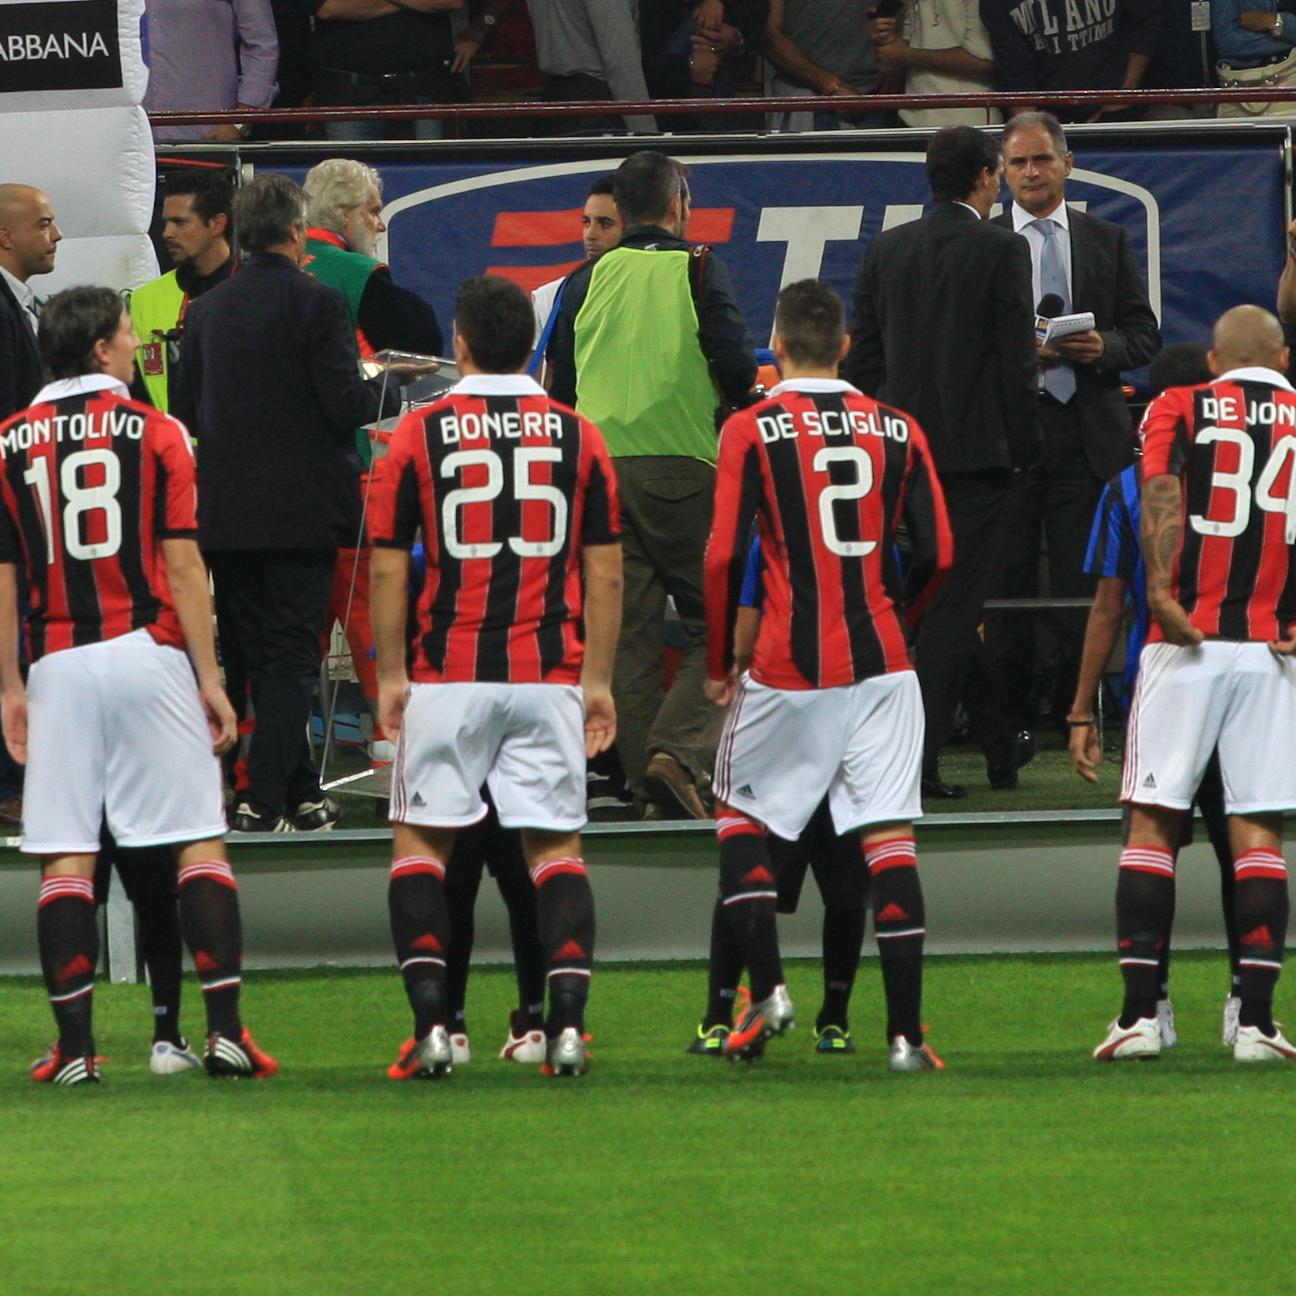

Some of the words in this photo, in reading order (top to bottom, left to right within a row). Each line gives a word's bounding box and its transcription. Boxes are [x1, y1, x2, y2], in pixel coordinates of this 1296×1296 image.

[440, 411, 564, 445] BONERA
[756, 412, 799, 444] DE
[801, 410, 910, 443] SCIGLIO
[1202, 397, 1239, 423] DE
[23, 448, 123, 565] 18
[440, 446, 569, 560] 25
[813, 446, 879, 557] 2
